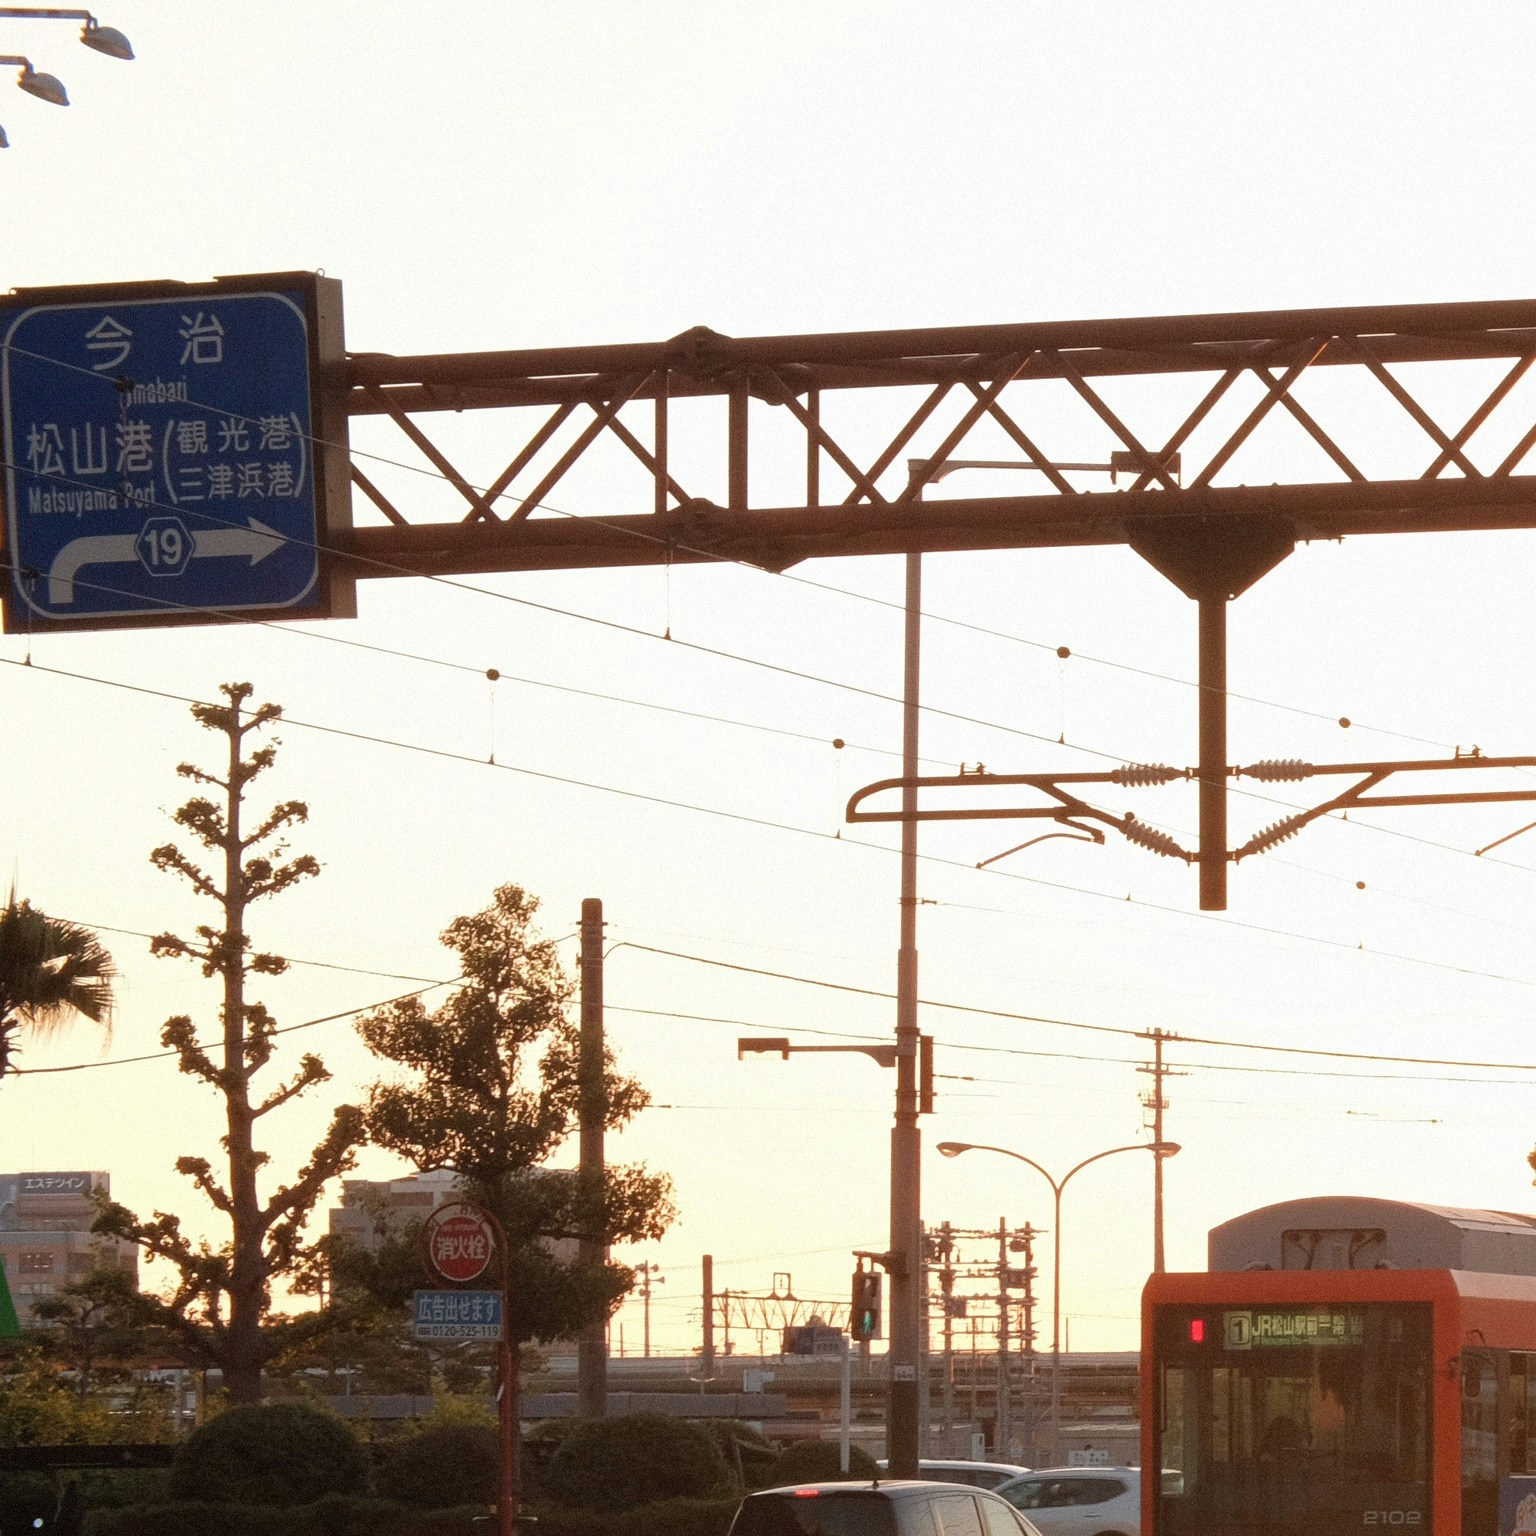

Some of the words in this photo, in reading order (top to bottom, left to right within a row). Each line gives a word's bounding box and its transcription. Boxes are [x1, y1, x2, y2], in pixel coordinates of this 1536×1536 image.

[85, 312, 225, 371] 今治
[27, 421, 153, 477] 松山港
[177, 415, 291, 454] 観光港
[28, 485, 118, 517] Matsuyama
[123, 480, 155, 508] Port
[179, 462, 293, 502] 三津浜港
[144, 528, 183, 566] 19
[436, 1234, 487, 1260] 消火栓
[419, 1294, 498, 1321] 広告出せます
[1363, 1510, 1421, 1525] 2102
